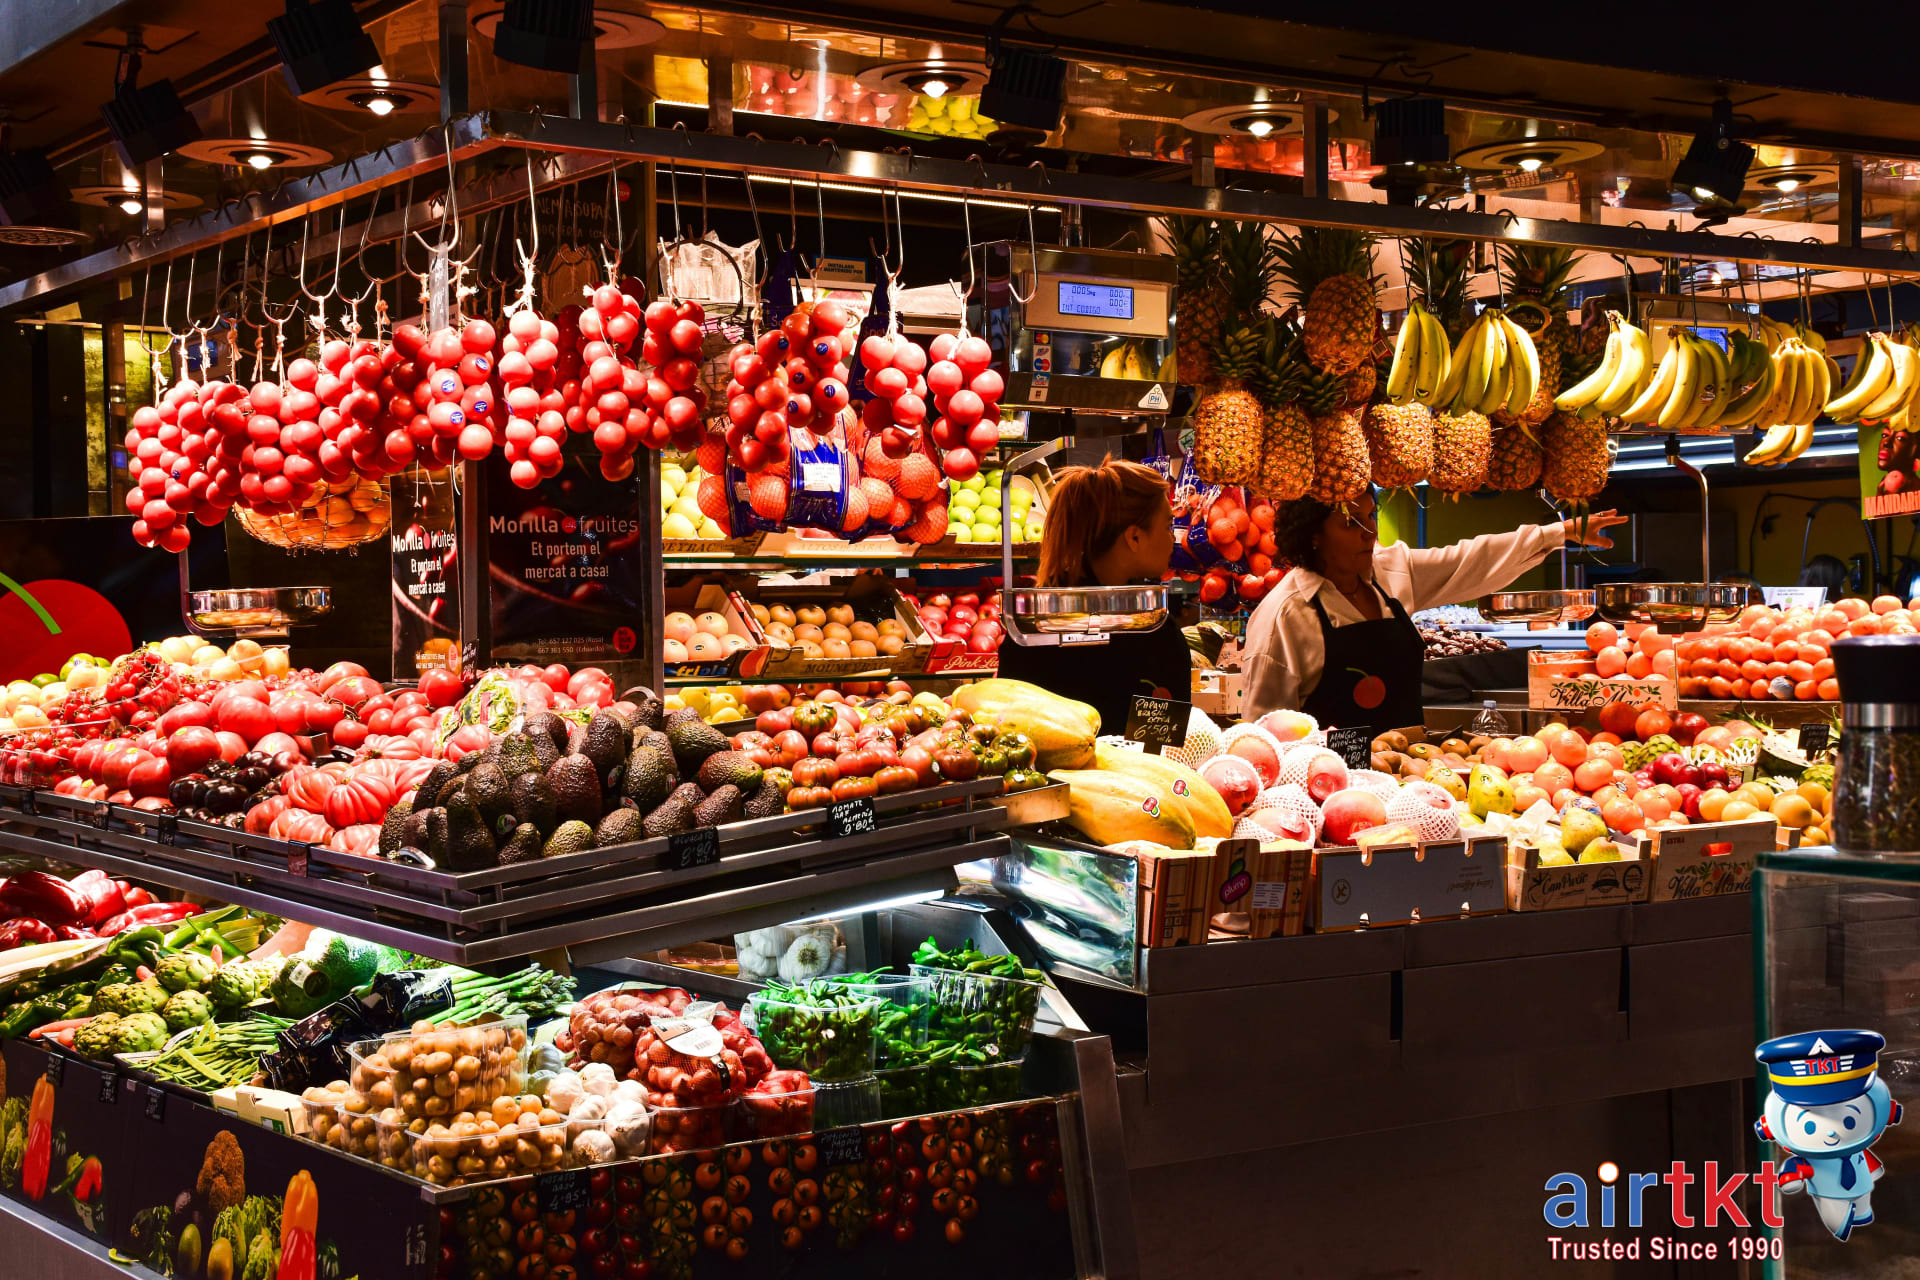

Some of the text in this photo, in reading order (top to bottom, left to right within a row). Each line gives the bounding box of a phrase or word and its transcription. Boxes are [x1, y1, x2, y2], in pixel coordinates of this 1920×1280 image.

[489, 515, 639, 534] Morilla fruites
[392, 529, 456, 553] Morilla fruites
[531, 540, 601, 560] Et portem el
[411, 556, 442, 576] Et portem el
[525, 565, 609, 579] mercat a casa!
[408, 581, 428, 596] mercat
[943, 654, 999, 670] Pink La
[1550, 687, 1590, 707] Villa
[1330, 730, 1357, 742] MANGO
[831, 799, 863, 813] TOMATE
[1223, 878, 1247, 899] plump
[1668, 874, 1702, 899] Villa
